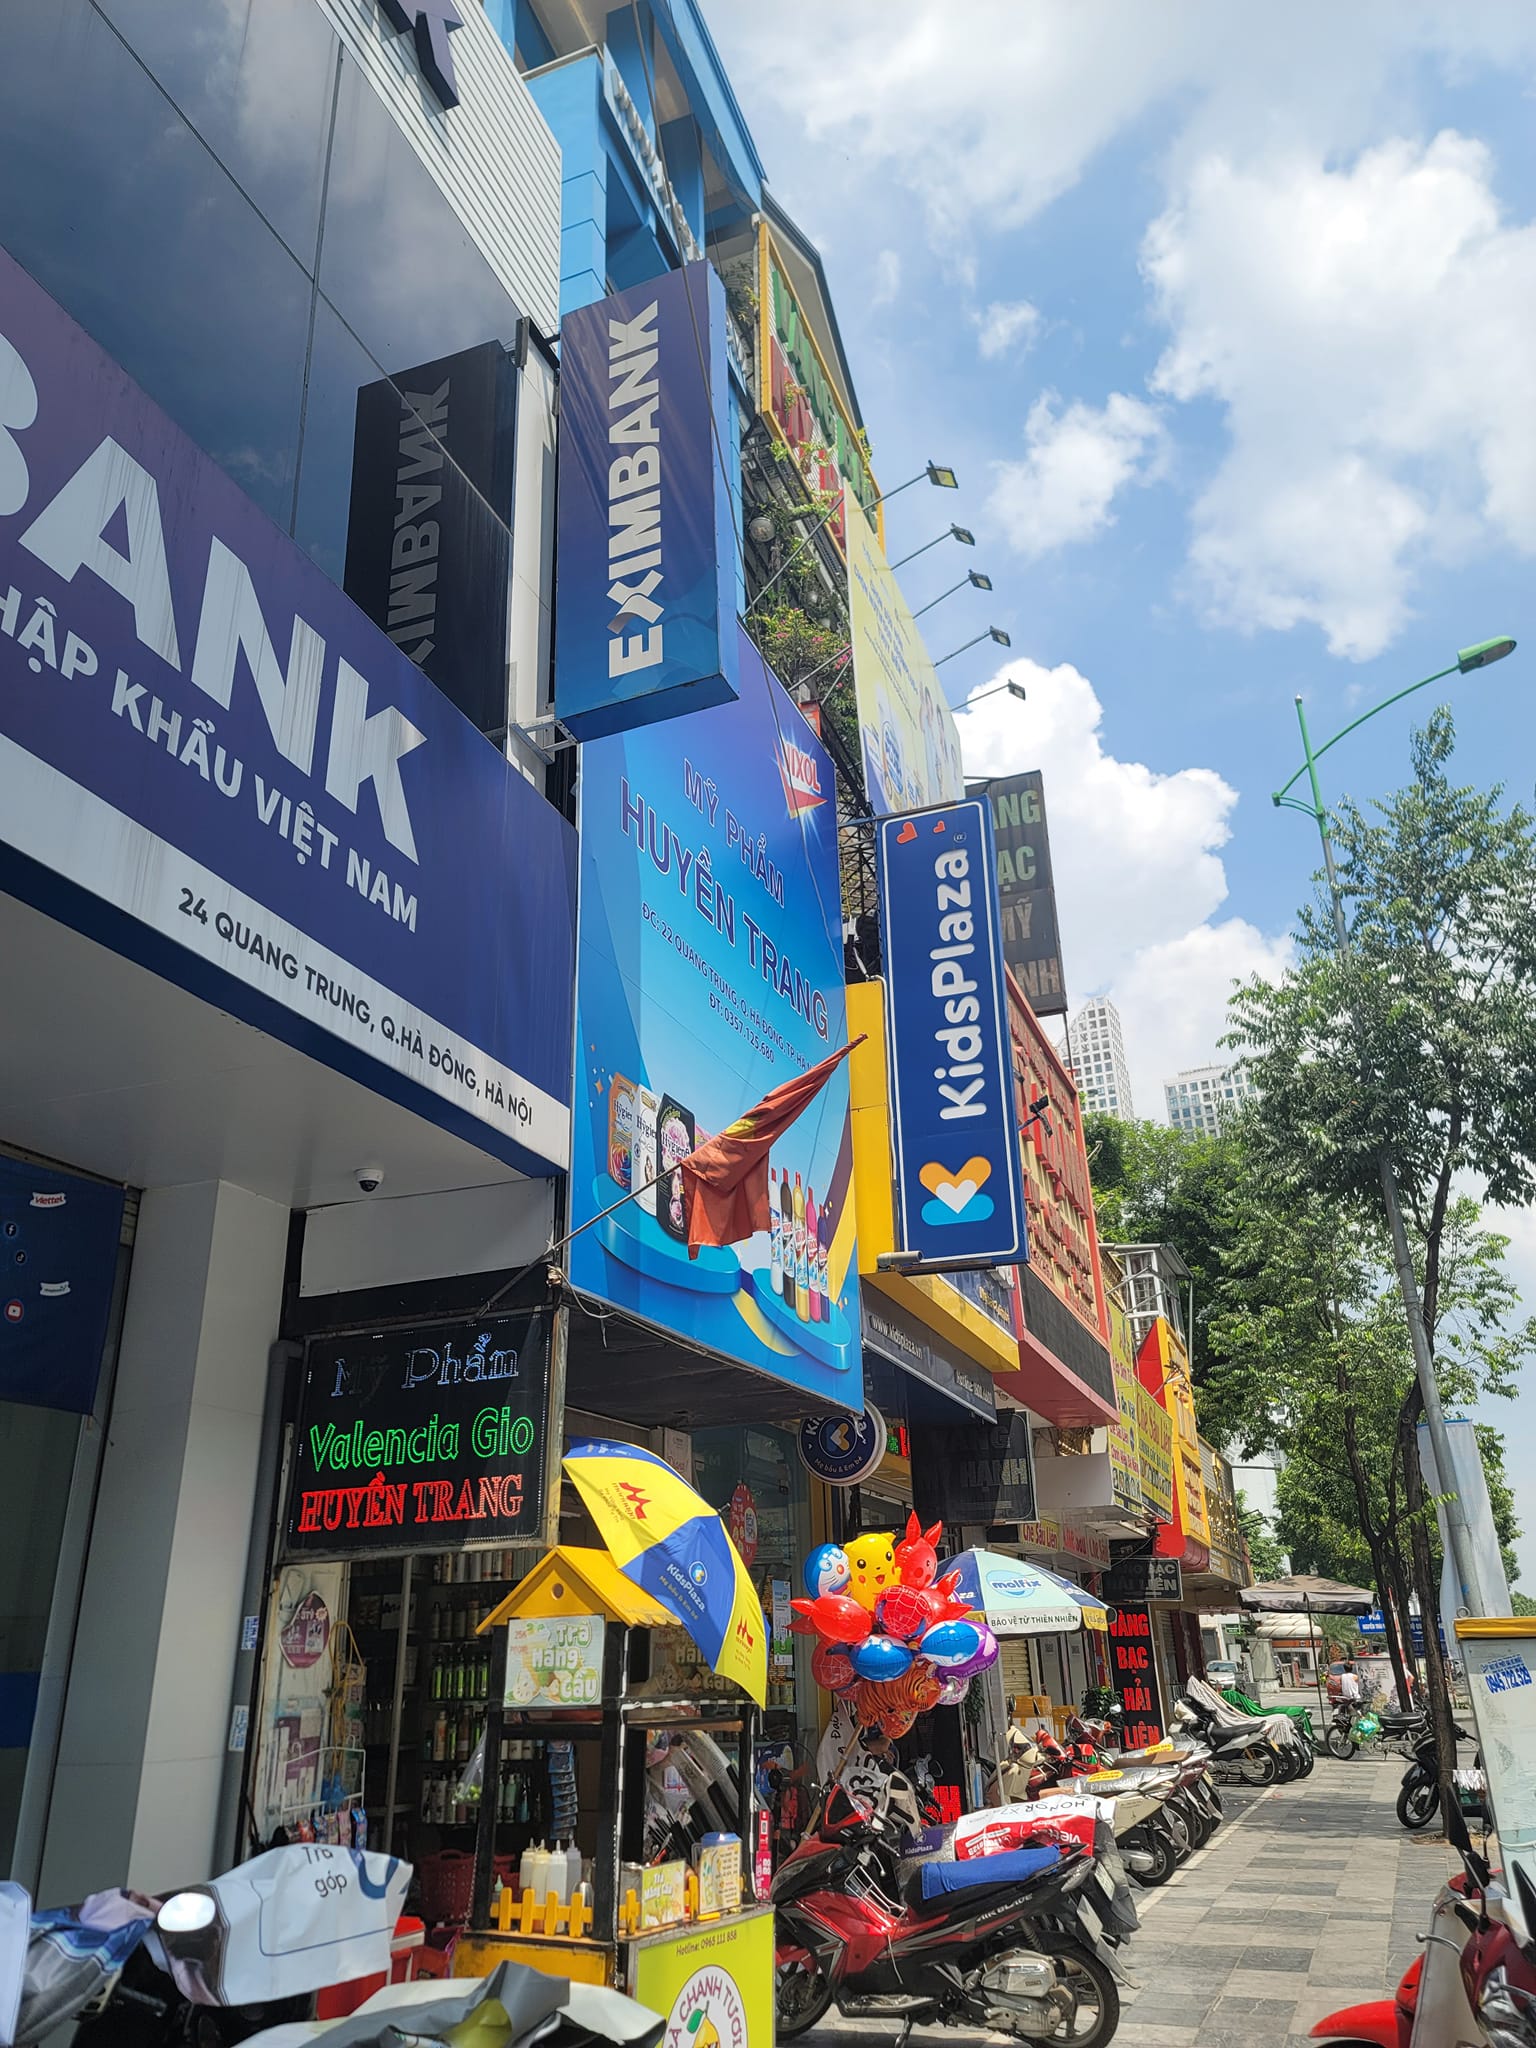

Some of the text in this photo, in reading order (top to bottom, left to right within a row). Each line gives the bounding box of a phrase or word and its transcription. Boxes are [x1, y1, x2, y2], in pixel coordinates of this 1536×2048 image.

[606, 299, 664, 679] EXIMBANK
[111, 668, 243, 798] KHẨU
[255, 773, 339, 870] VIỆT
[346, 848, 418, 933] NAM
[684, 757, 785, 909] MỸ PHẨM
[620, 775, 830, 1044] HUYỀN TRANG
[641, 902, 660, 931] ĐC:
[660, 920, 674, 946] 22
[674, 934, 709, 978] QUANG
[708, 968, 741, 1010] TRUNG,
[178, 887, 209, 926] 24
[214, 911, 299, 980] QUANG
[304, 964, 375, 1033] TRUNG,
[428, 1048, 481, 1097] ĐÔNG,
[484, 1079, 505, 1110] HÀ
[508, 1099, 533, 1127] NỘI
[708, 991, 724, 1017] ĐT:
[930, 847, 987, 1121] KidsPlaza
[401, 1331, 519, 1390] Phẩm
[309, 1406, 535, 1473] Valencia Gio
[298, 1470, 524, 1534] HUYỀN TRANG
[666, 1562, 705, 1613] KidsPlaza
[991, 1579, 1042, 1590] molfix
[991, 1615, 1007, 1628] BẢO
[1031, 1612, 1054, 1624] THIÊN
[1053, 1611, 1079, 1624] NHIÊN
[1116, 1646, 1149, 1675] BẠC
[1123, 1677, 1152, 1712] HẢI
[1123, 1720, 1161, 1751] LIÊN
[314, 1869, 348, 1898] góp
[675, 1941, 701, 1957] Hotline:
[679, 1975, 723, 2023] CHANH
